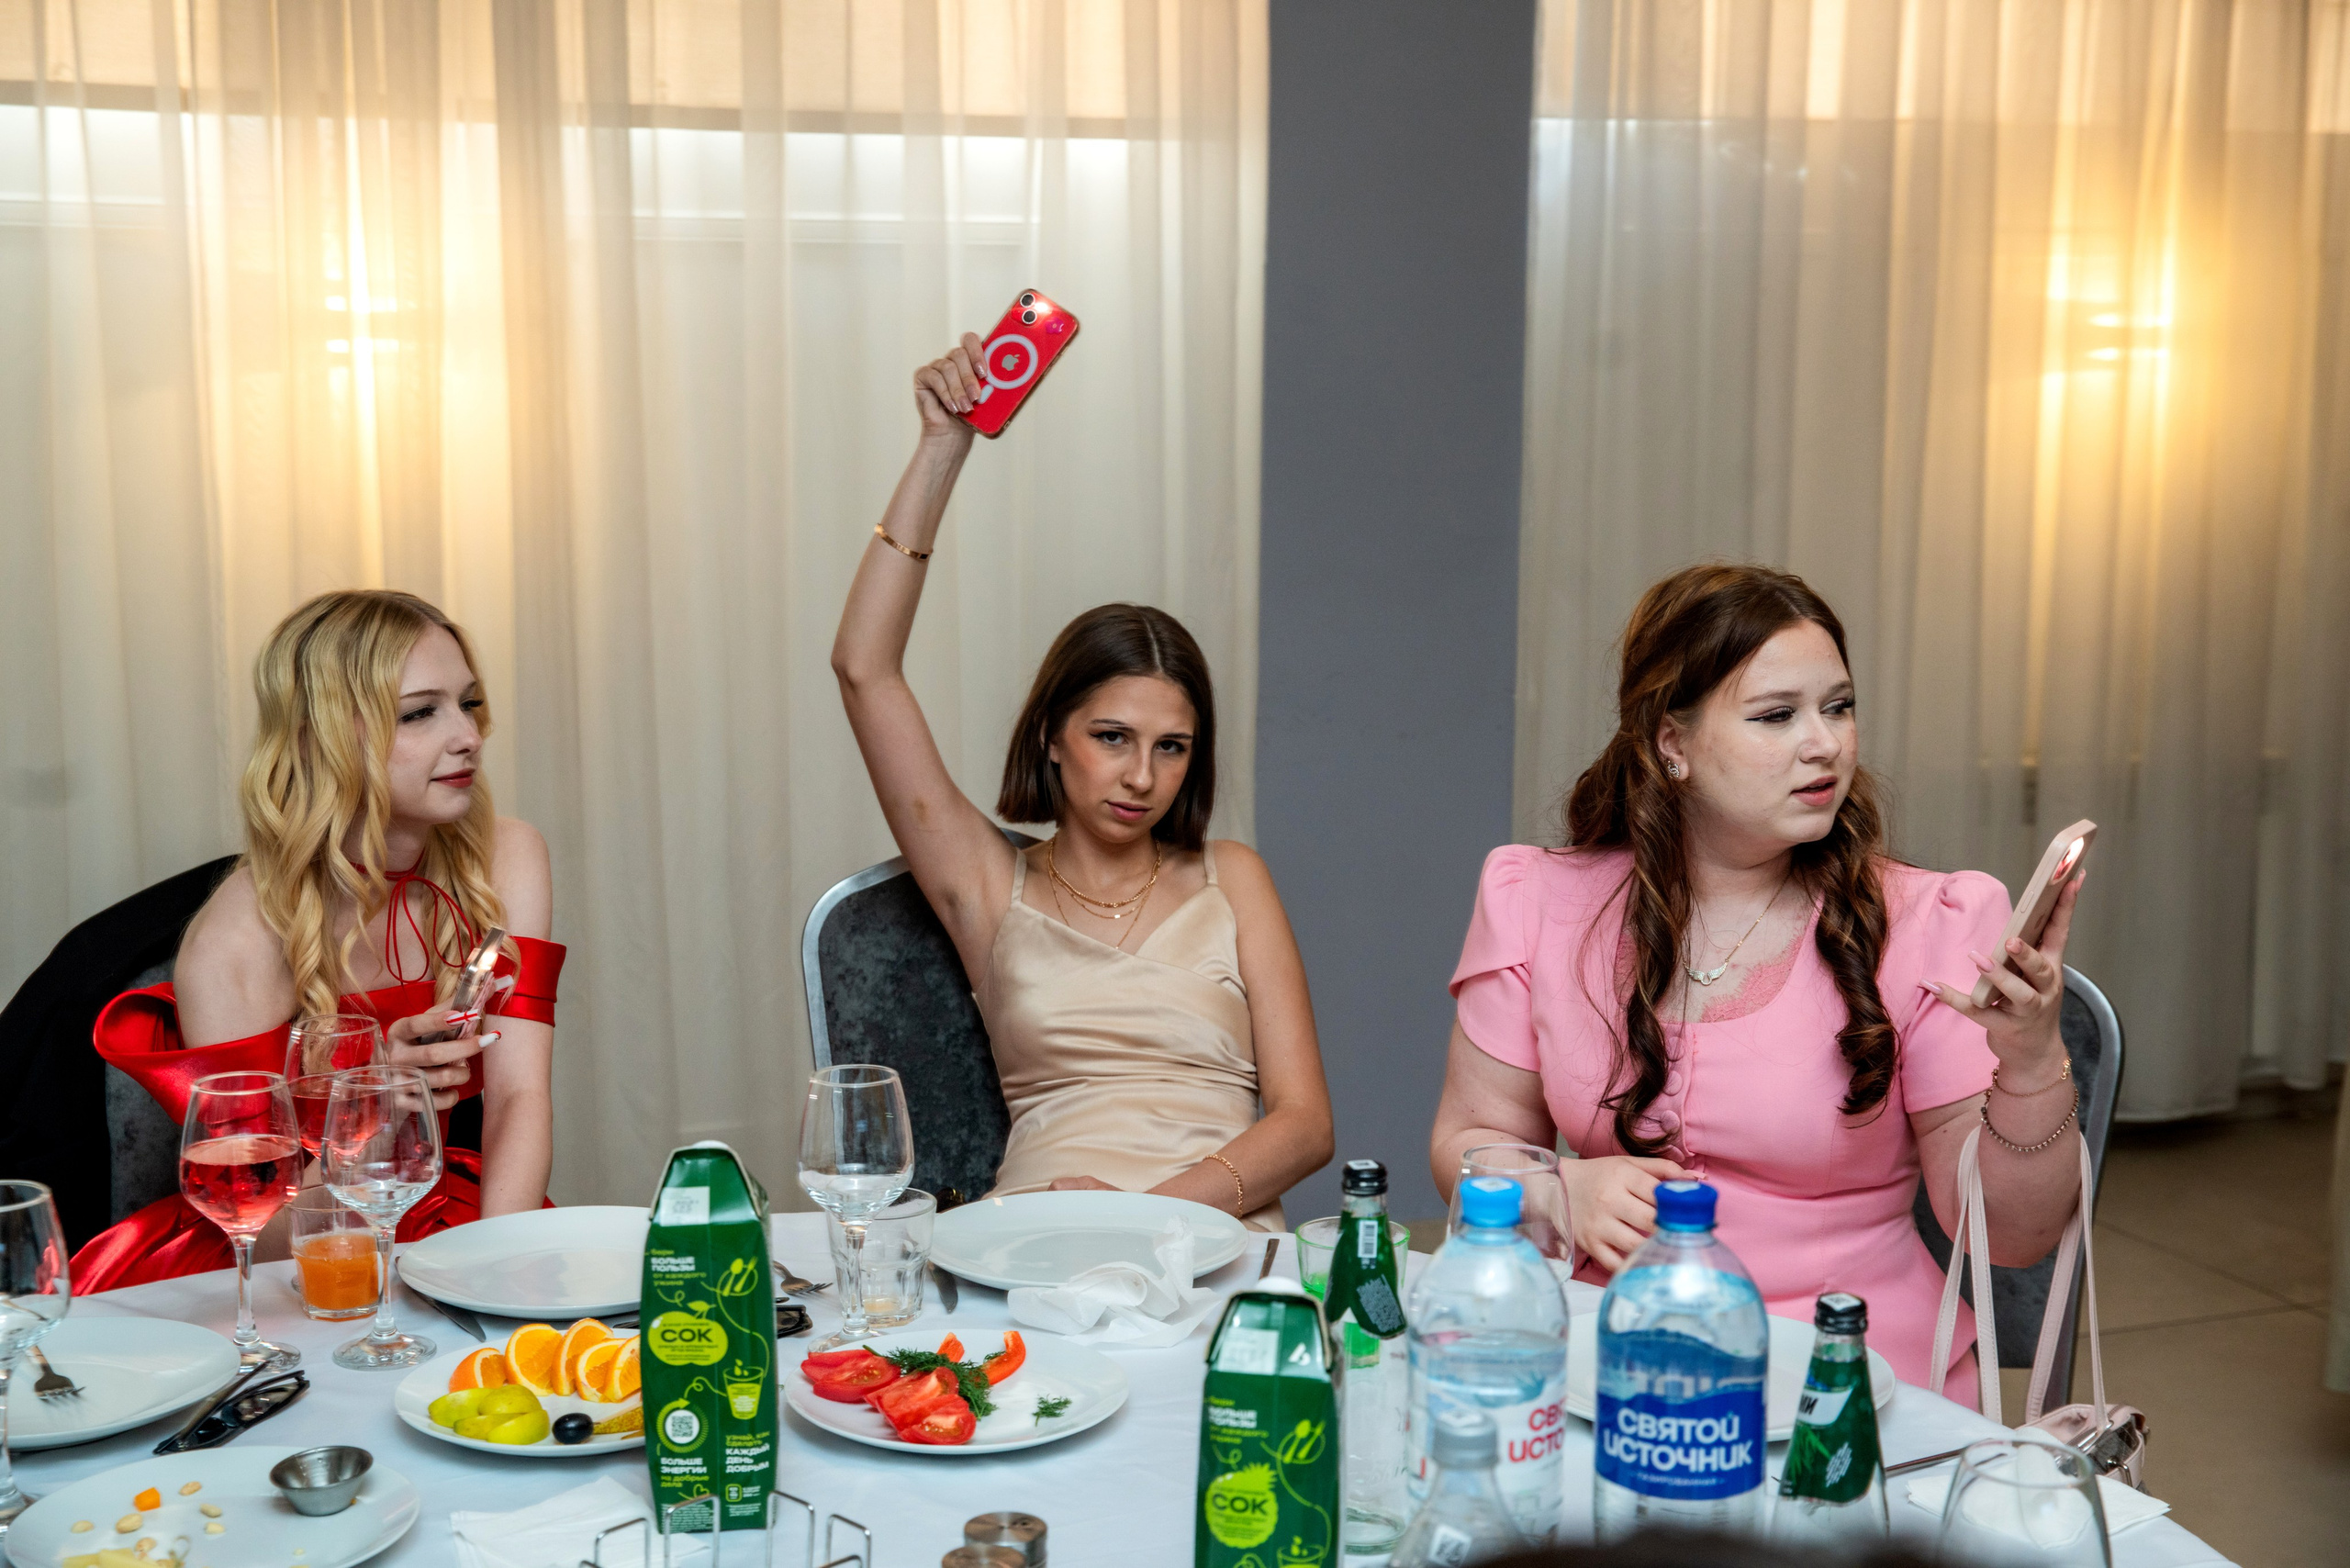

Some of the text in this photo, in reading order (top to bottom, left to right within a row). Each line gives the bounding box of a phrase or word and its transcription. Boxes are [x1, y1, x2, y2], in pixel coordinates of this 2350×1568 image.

[660, 1327, 713, 1343] СОК
[1617, 1406, 1740, 1445] СВЯТОЙ
[725, 1442, 770, 1457] КАЖДЫЙ
[1603, 1428, 1753, 1473] ИСТОЧНИК
[660, 1457, 703, 1466] БОЛЬШЕ
[725, 1456, 755, 1465] ДЕНЬ
[725, 1461, 770, 1473] ДОБРЫМ
[660, 1465, 708, 1474] ЭНЕРГИИ
[1213, 1493, 1269, 1517] СОК
